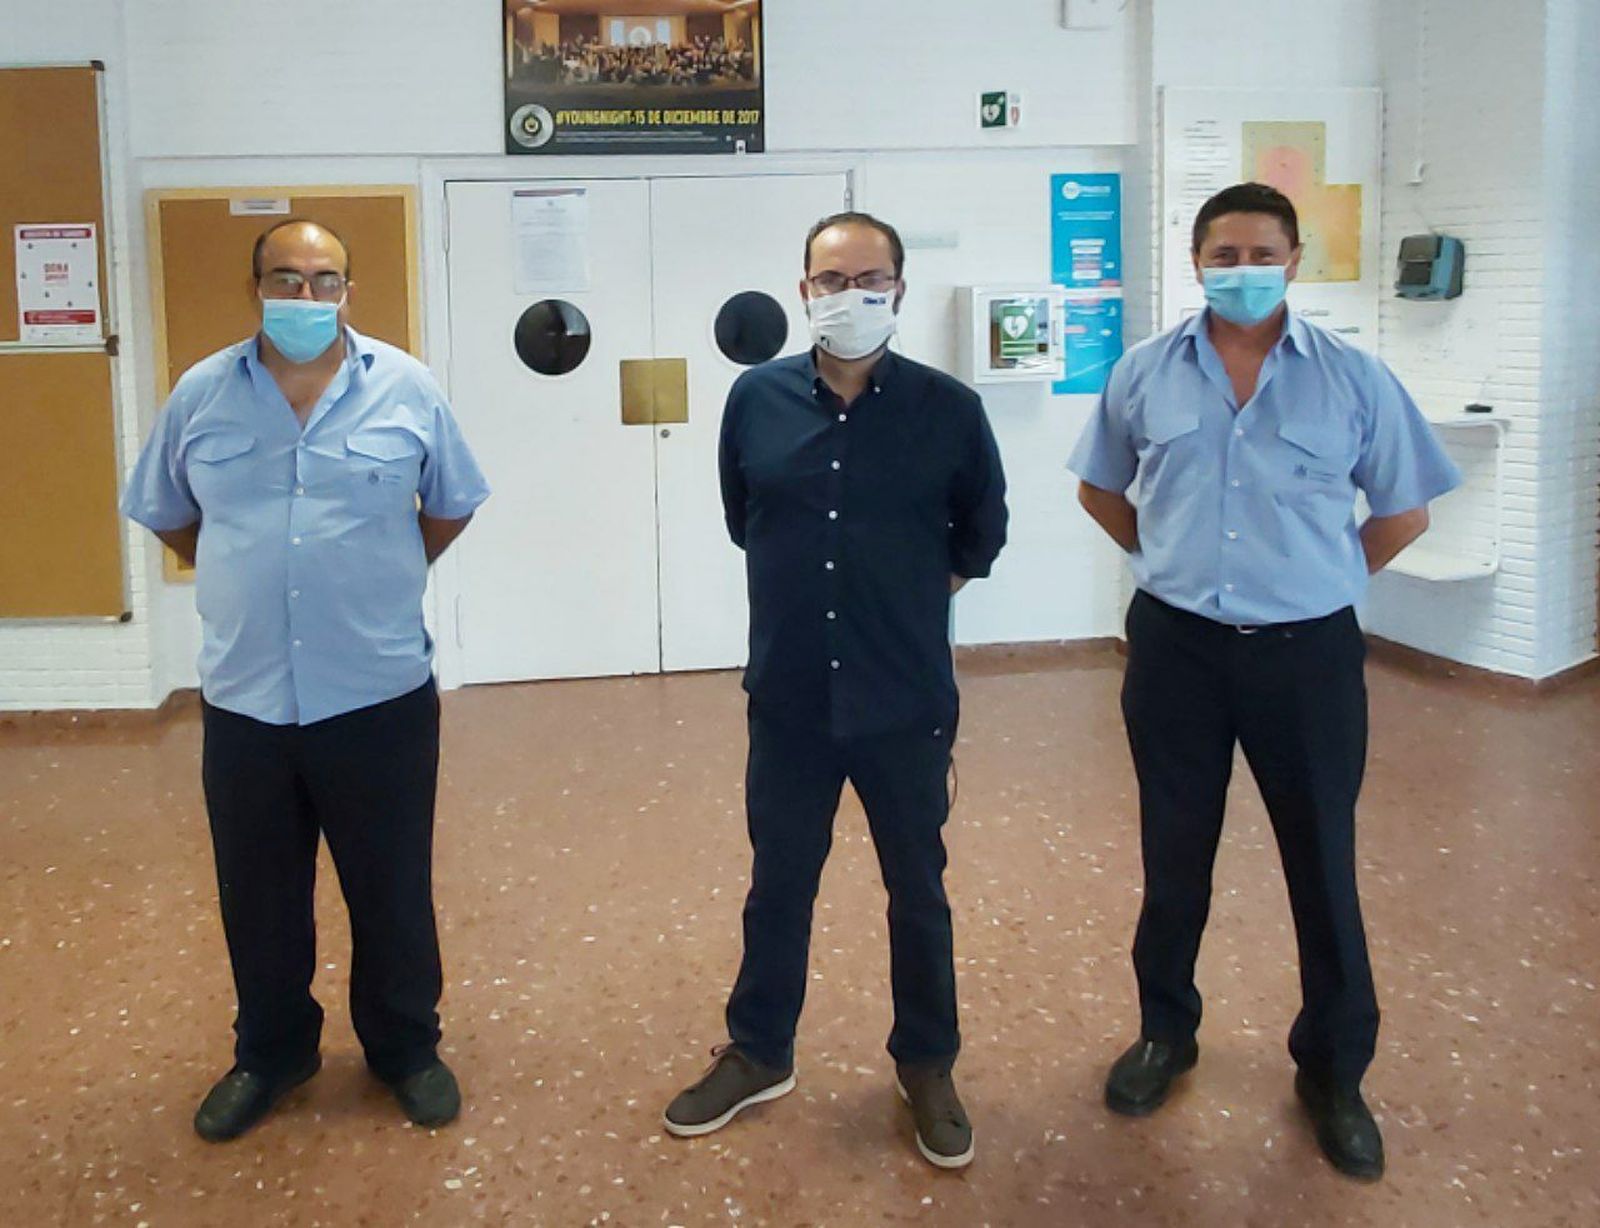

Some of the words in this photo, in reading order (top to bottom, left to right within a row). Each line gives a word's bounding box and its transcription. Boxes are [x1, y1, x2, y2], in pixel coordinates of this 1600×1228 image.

[648, 110, 661, 124] DE
[664, 110, 720, 124] DICIEMBRE
[722, 110, 735, 124] DE
[737, 110, 760, 124] 2017
